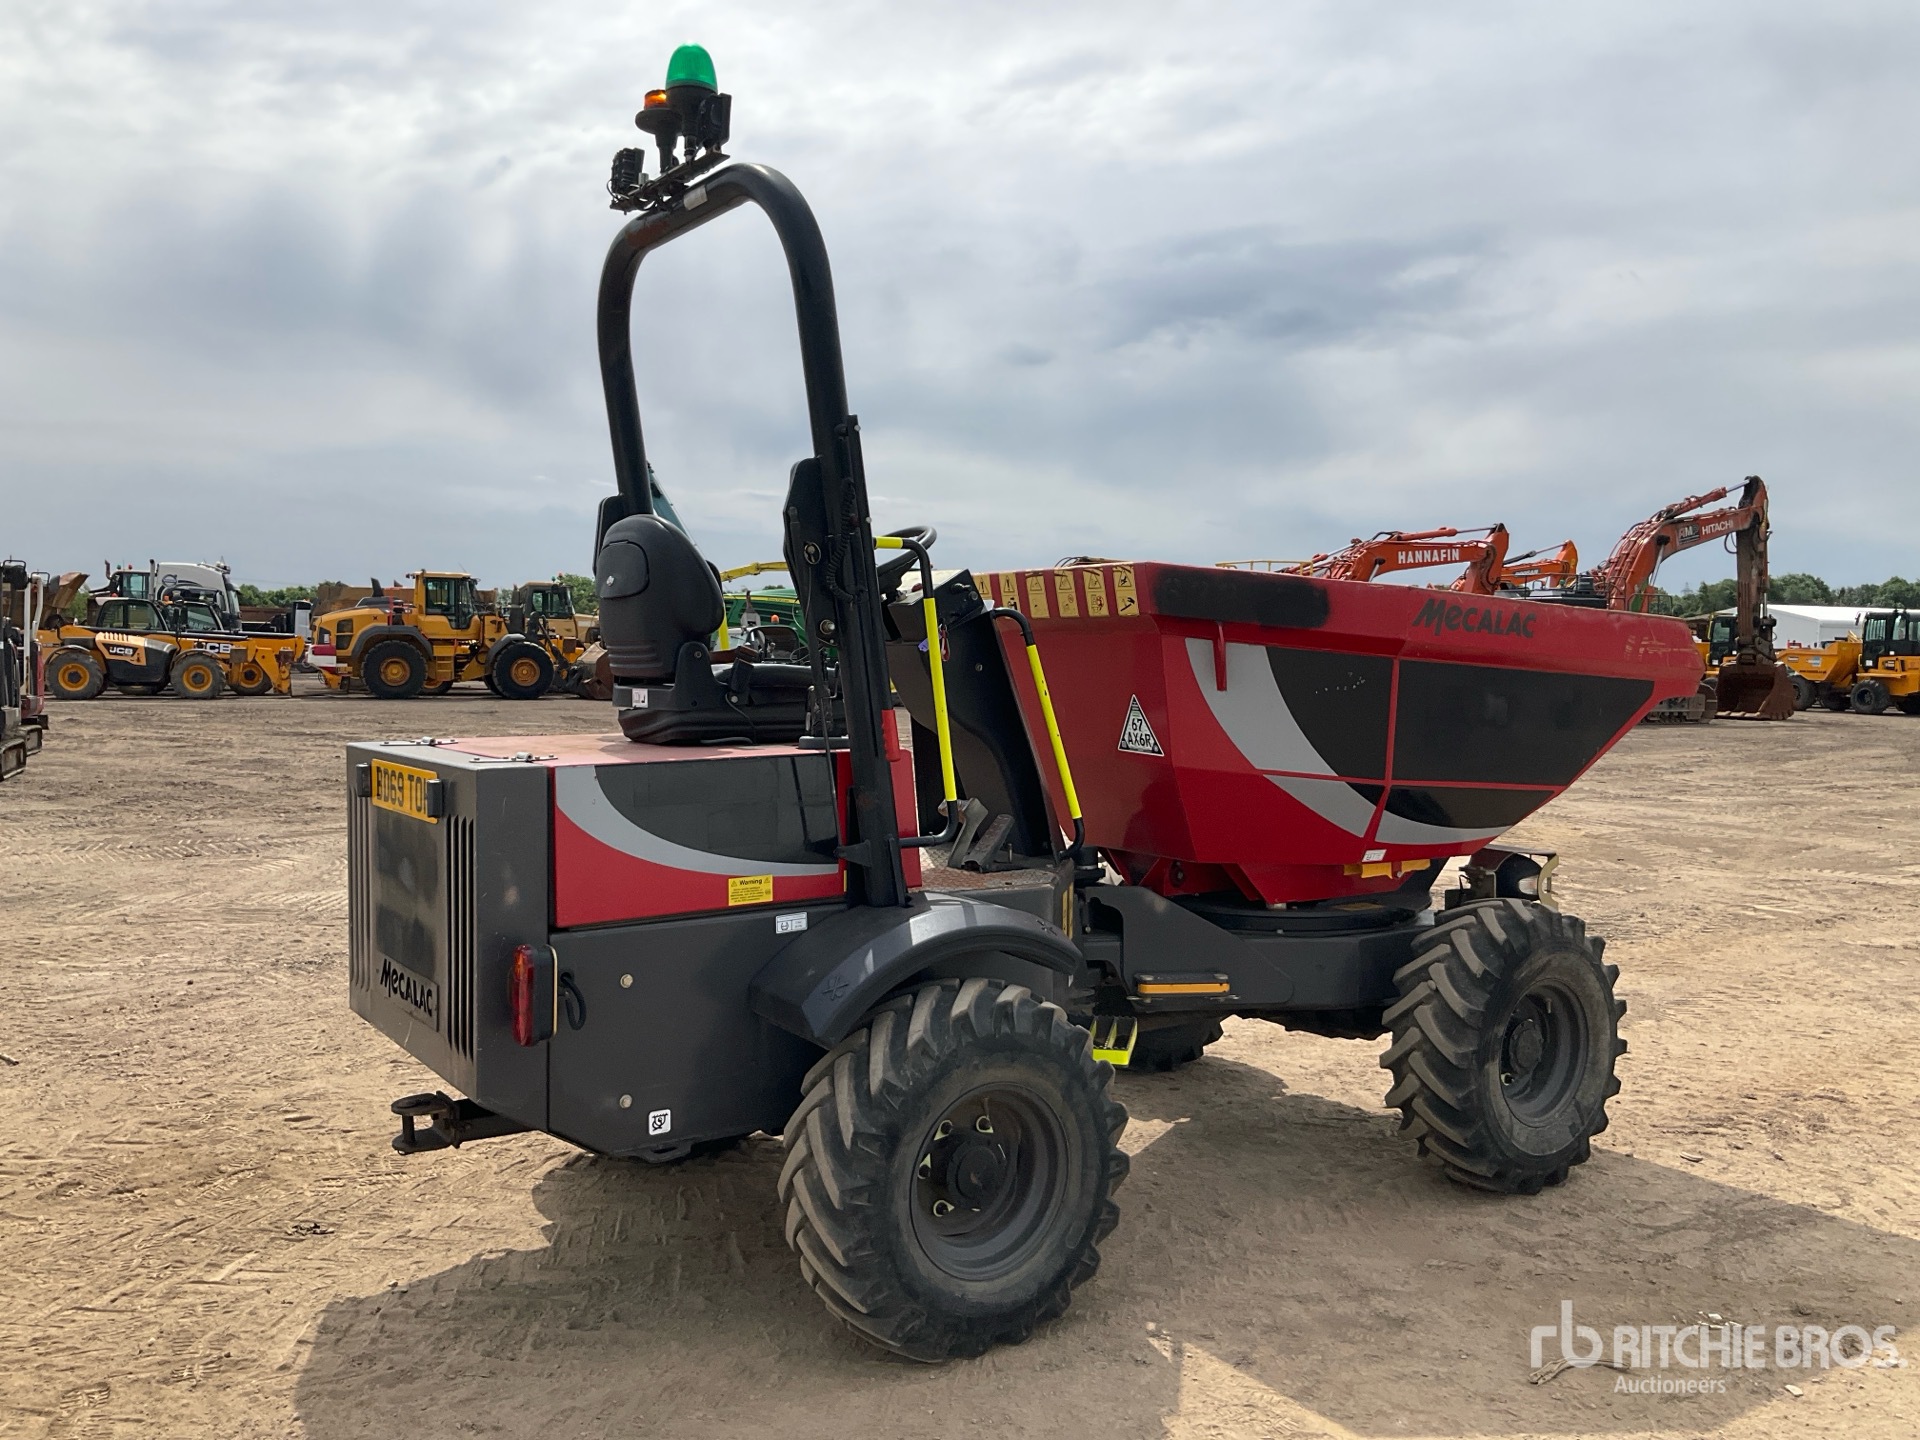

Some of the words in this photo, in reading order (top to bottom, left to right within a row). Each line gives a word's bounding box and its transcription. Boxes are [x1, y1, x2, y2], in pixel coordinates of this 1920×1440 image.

[1702, 520, 1734, 535] HITACHI
[1398, 548, 1460, 564] HANNAFIN
[109, 646, 134, 656] JCB
[1131, 718, 1143, 731] 67
[1127, 731, 1152, 748] AX6R
[739, 878, 763, 887] Warning
